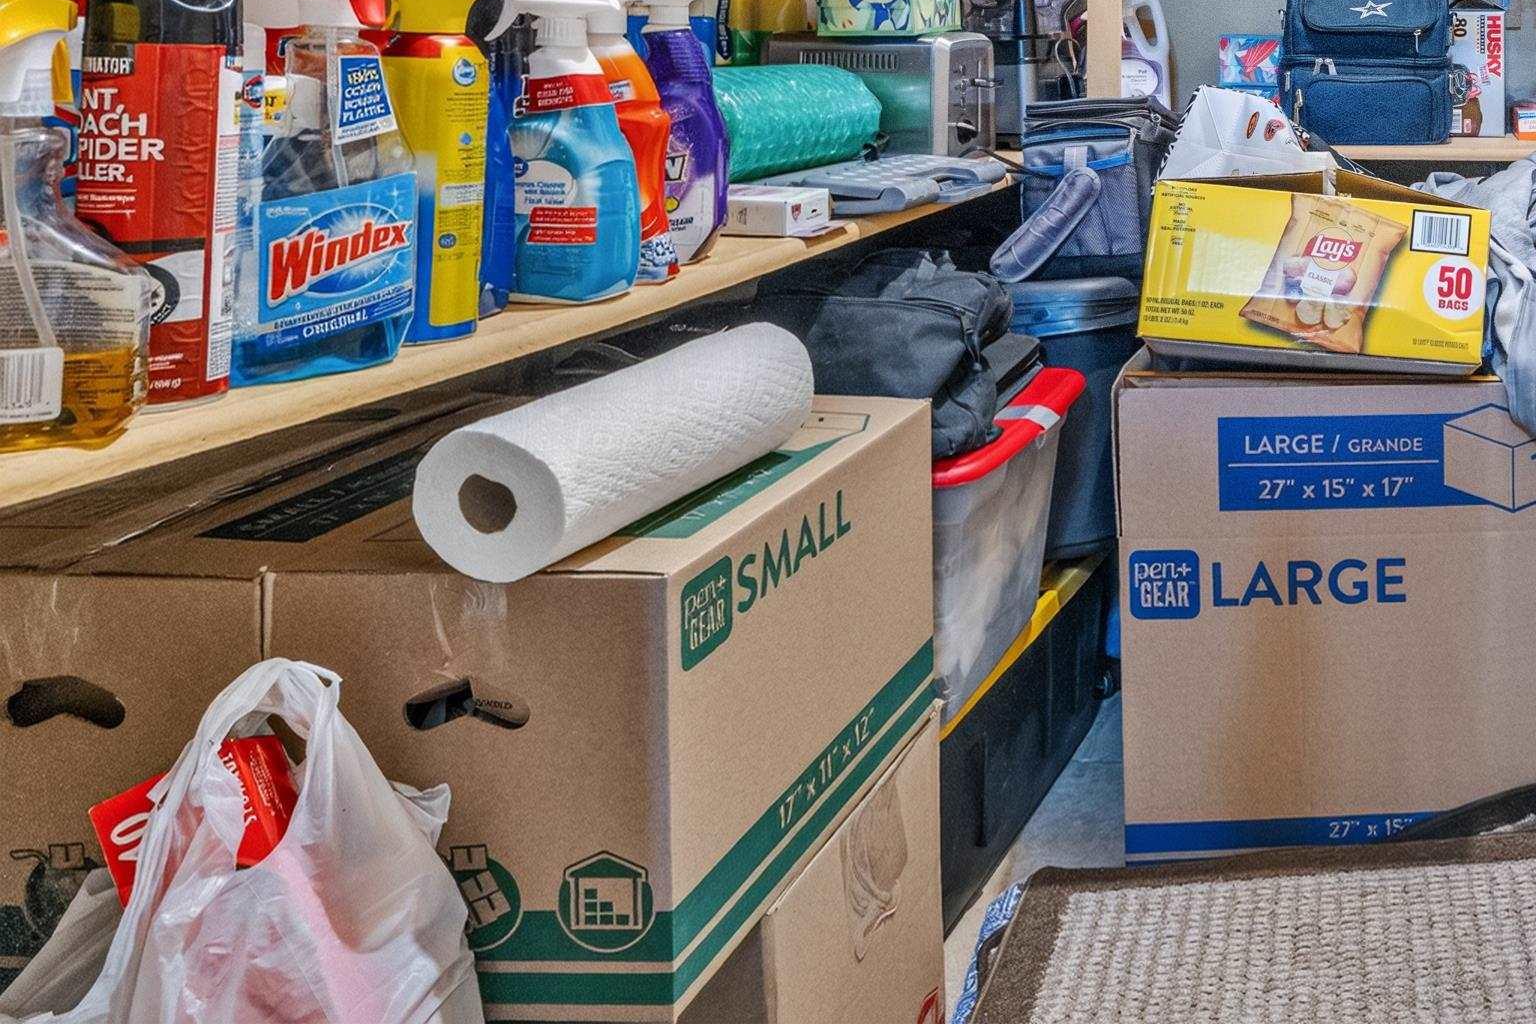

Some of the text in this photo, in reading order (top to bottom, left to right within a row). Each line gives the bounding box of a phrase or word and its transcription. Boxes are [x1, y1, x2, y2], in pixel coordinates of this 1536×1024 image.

[1486, 15, 1502, 78] HUSKY
[82, 88, 126, 115] NT,
[79, 113, 148, 137] ACH
[79, 138, 165, 162] PIDER
[1311, 235, 1356, 261] Lay's
[268, 219, 411, 305] Windex
[1437, 265, 1473, 300] 50
[1438, 298, 1469, 312] BAGS
[1245, 434, 1324, 455] LARGE
[1348, 437, 1424, 453] GRANDE
[1258, 475, 1415, 500] 27" x 15" x 17"
[736, 490, 852, 614] SMALL
[1140, 581, 1190, 608] GEAR
[1211, 557, 1407, 608] LARGE
[689, 598, 726, 652] GEAR
[1366, 824, 1379, 838] x
